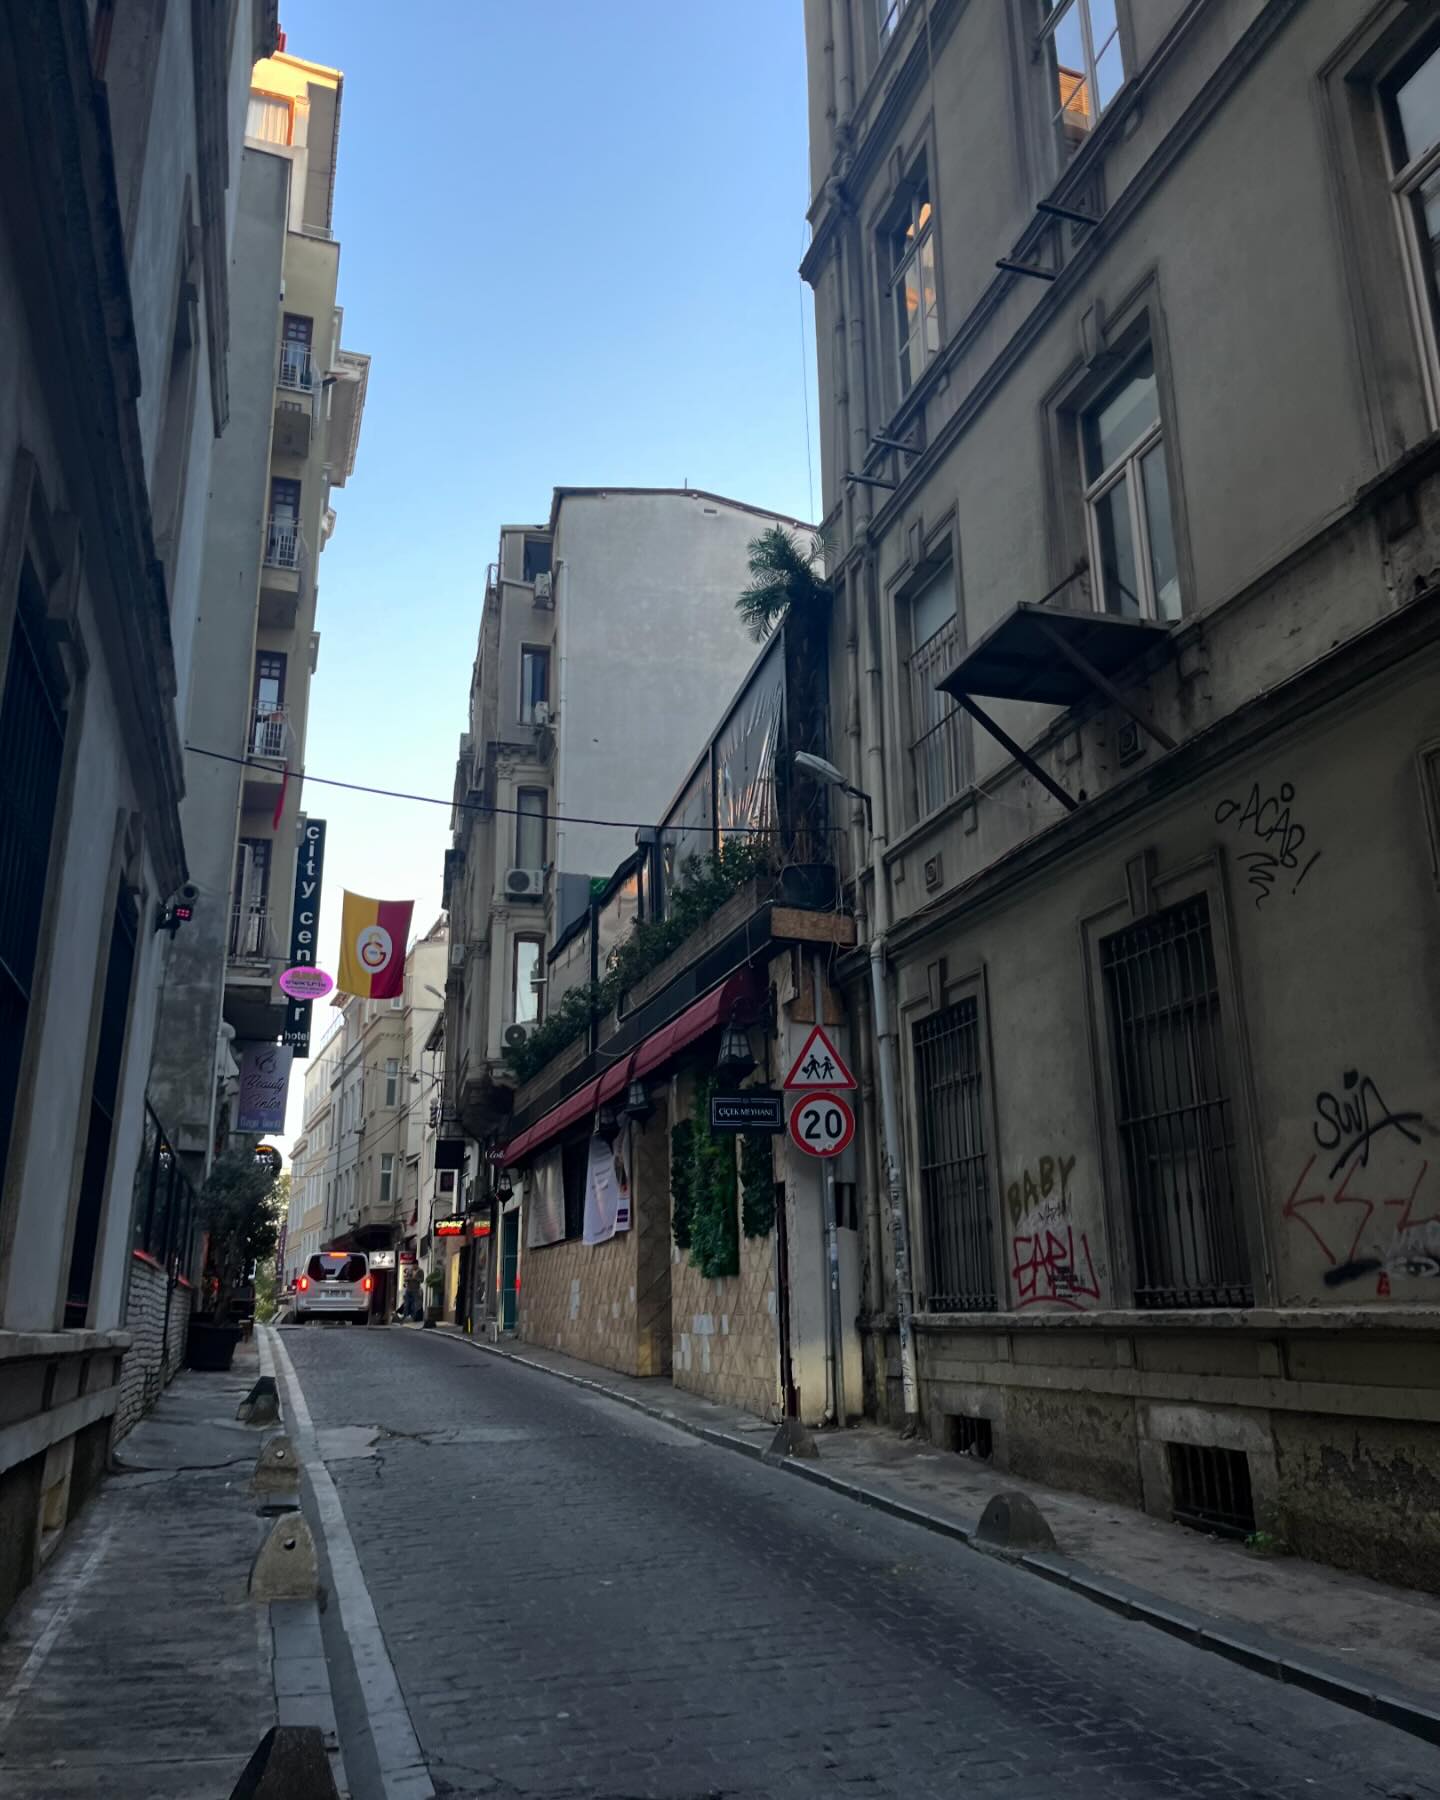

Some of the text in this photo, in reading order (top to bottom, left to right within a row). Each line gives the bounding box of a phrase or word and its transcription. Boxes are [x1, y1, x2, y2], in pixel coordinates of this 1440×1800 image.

[302, 826, 320, 900] city
[294, 910, 313, 1022] cenr
[284, 1031, 310, 1043] hotel
[244, 1074, 285, 1094] Beauty
[741, 1106, 774, 1117] MEYHANE
[804, 1109, 842, 1139] 20
[1008, 1154, 1076, 1229] BABY
